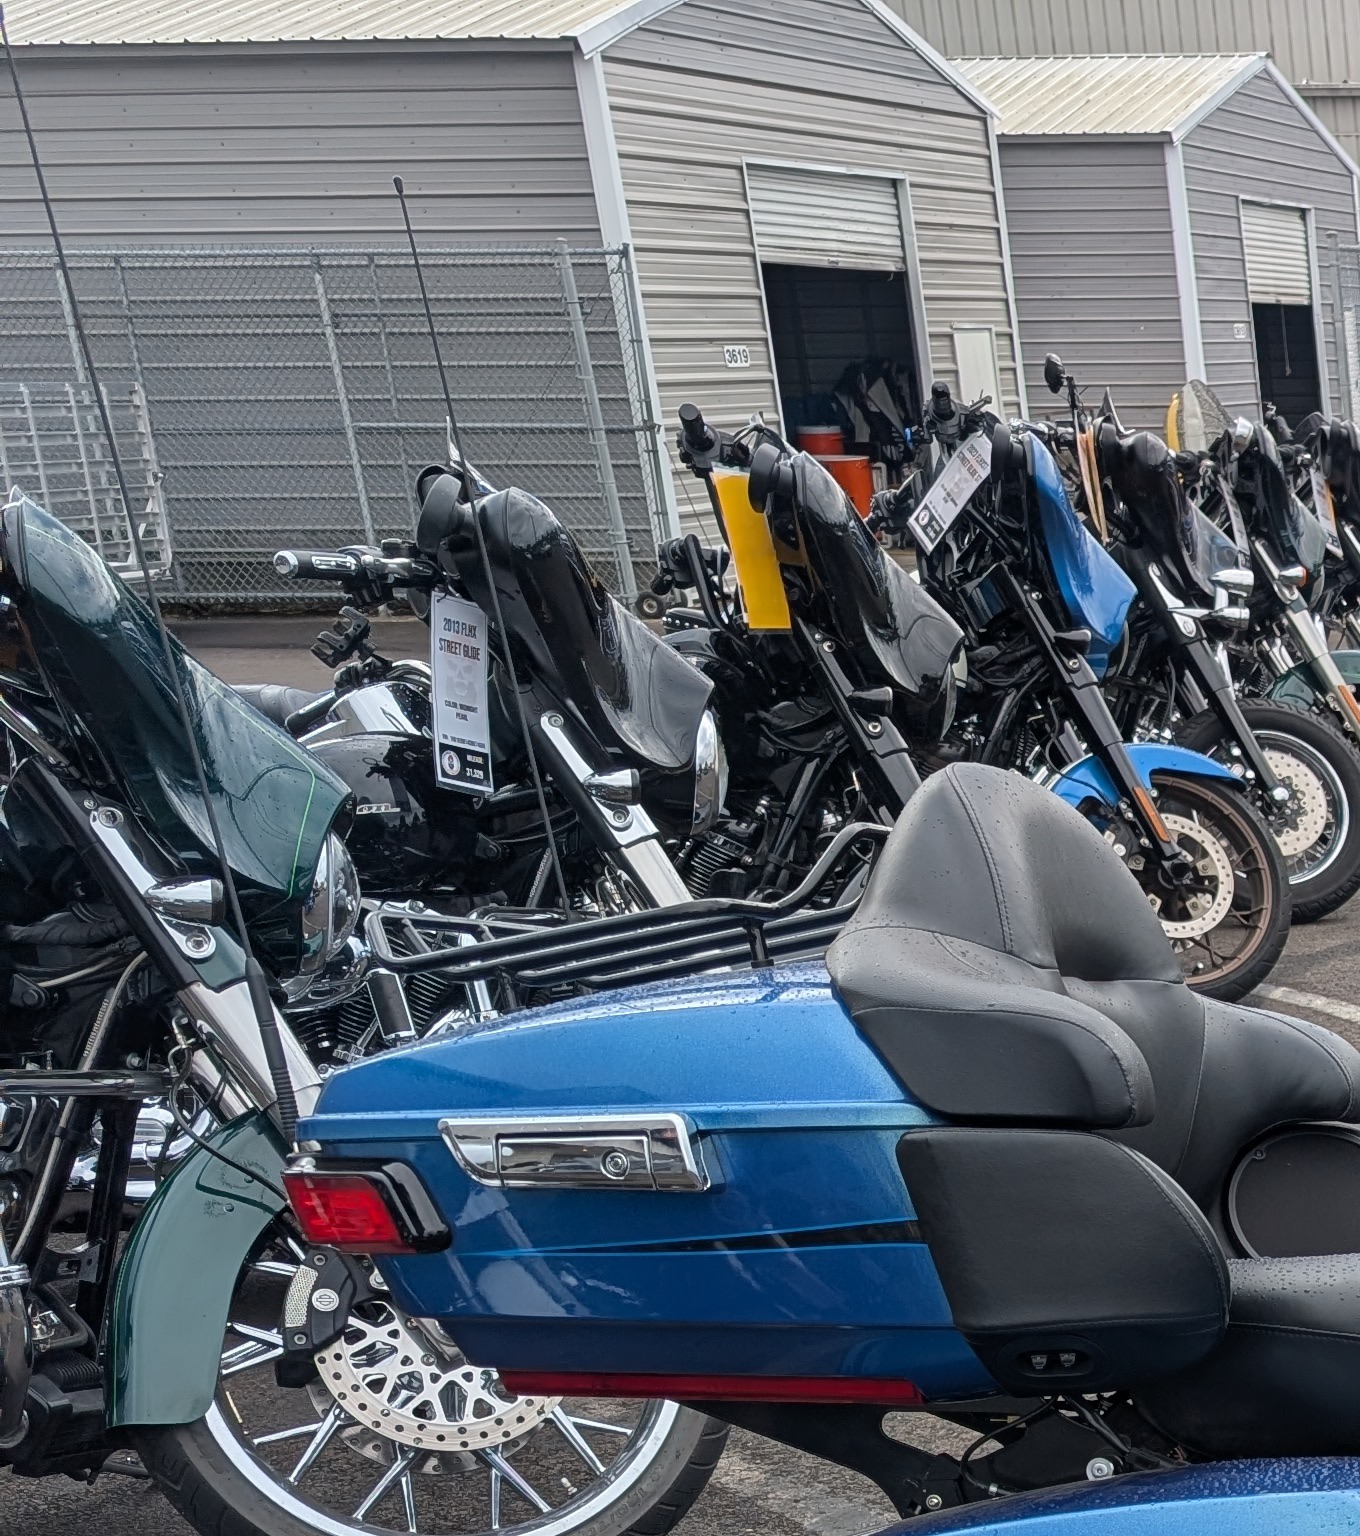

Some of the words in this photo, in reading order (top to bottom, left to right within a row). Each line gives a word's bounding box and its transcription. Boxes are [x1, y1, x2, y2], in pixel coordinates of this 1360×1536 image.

[725, 349, 749, 363] 3619
[443, 617, 460, 635] 2013
[438, 637, 461, 656] STREET
[462, 642, 481, 662] GLIDE
